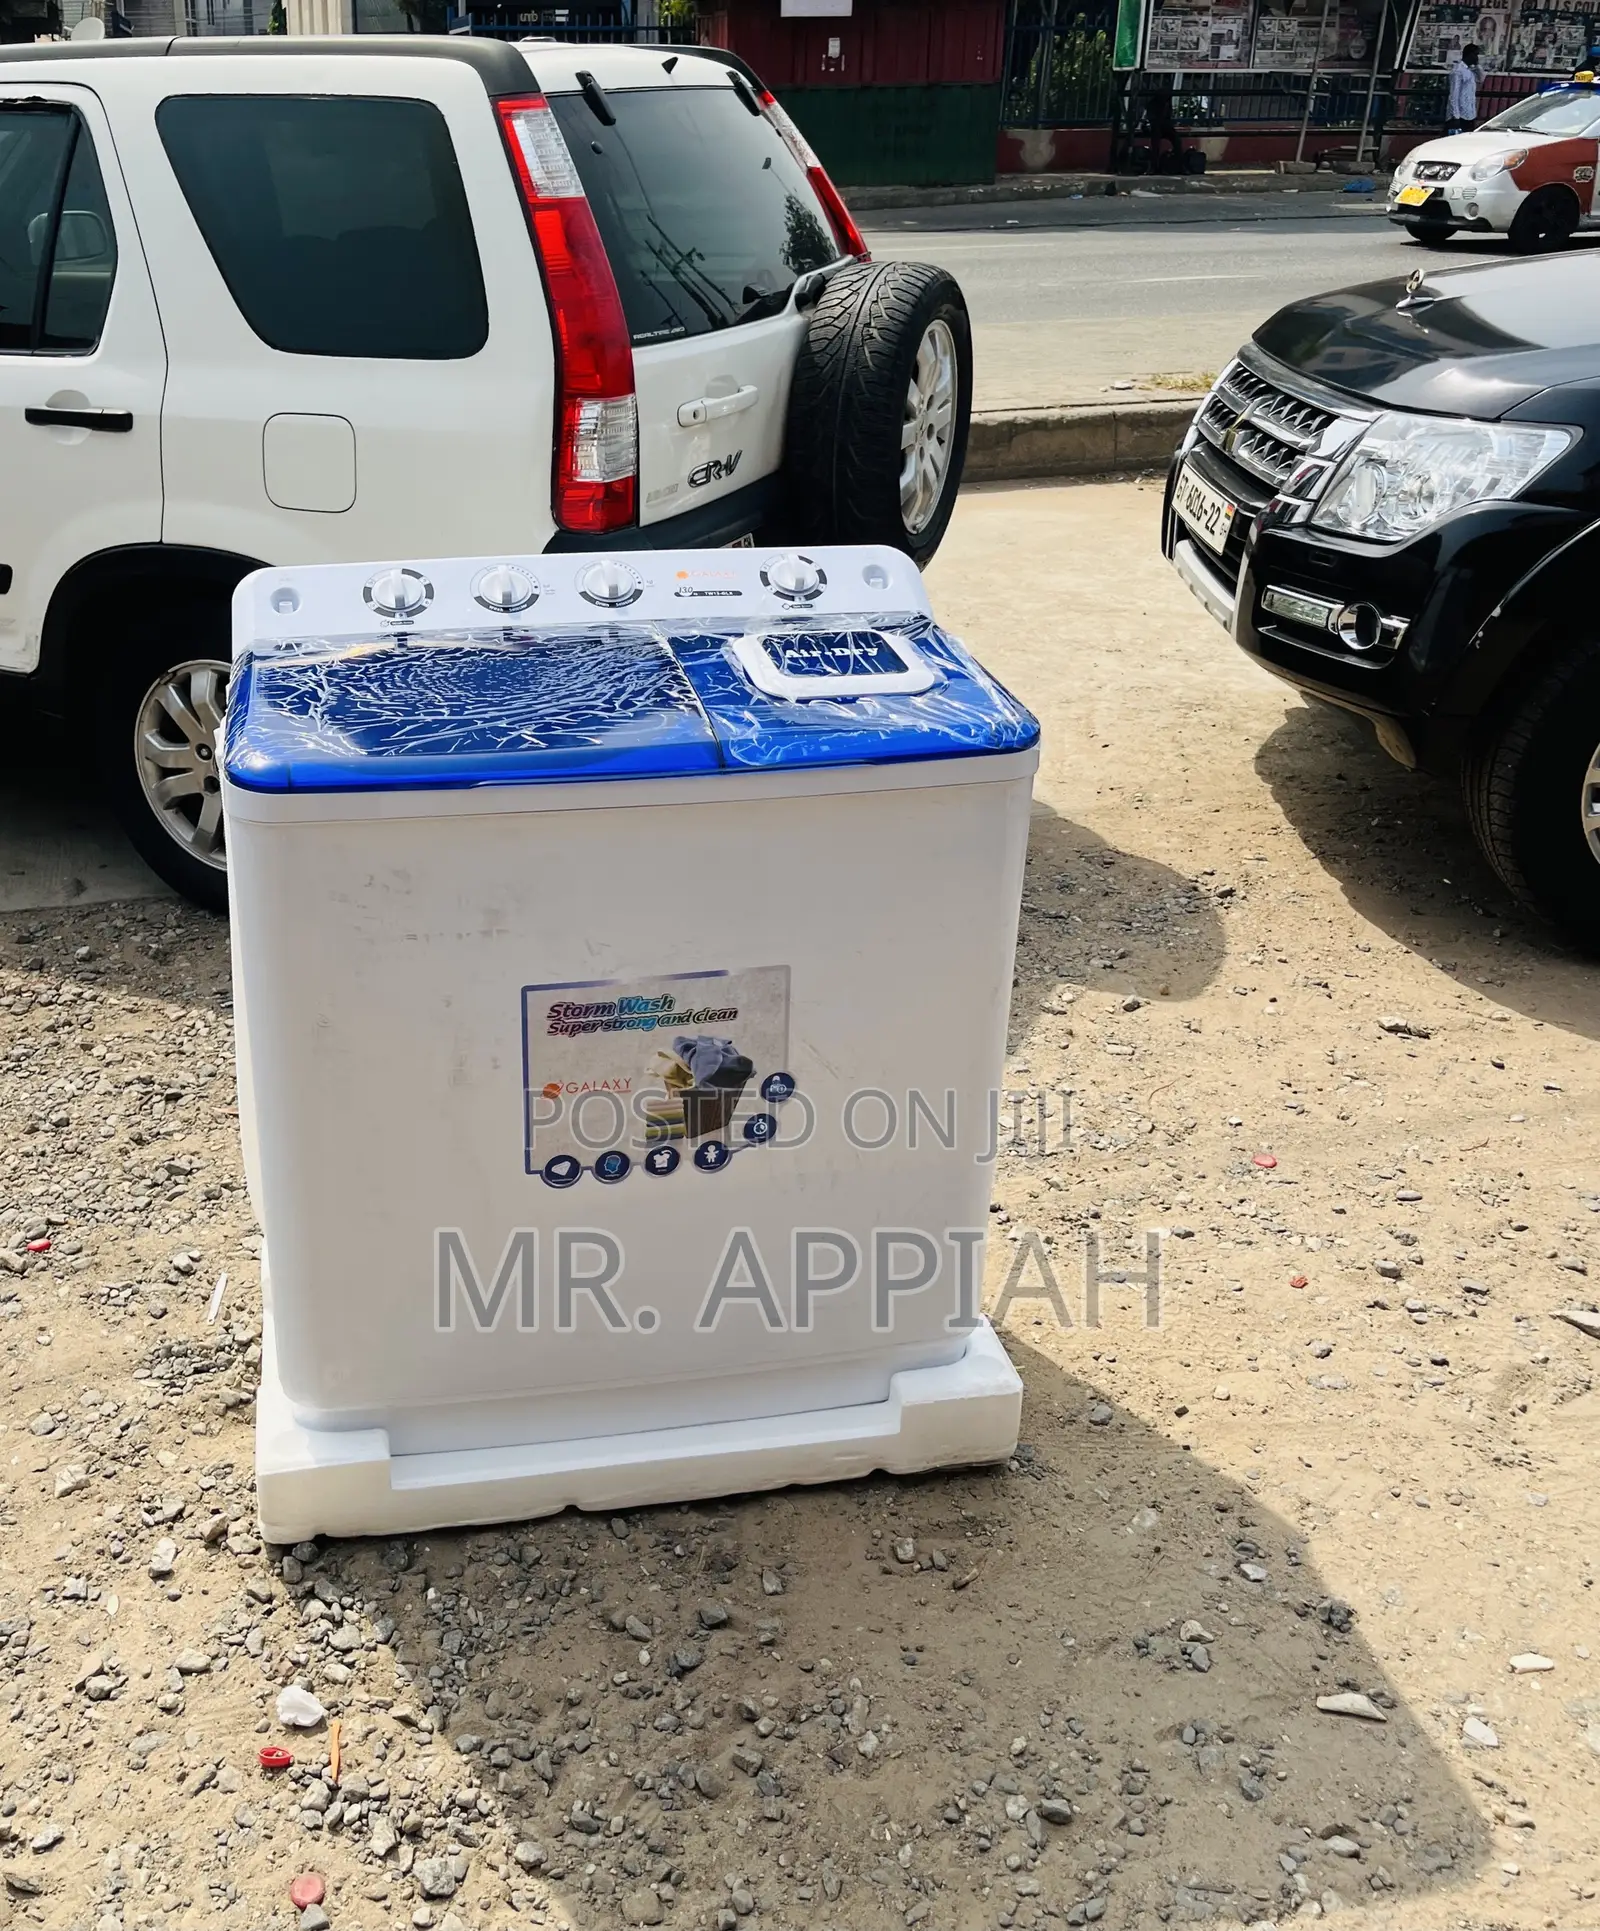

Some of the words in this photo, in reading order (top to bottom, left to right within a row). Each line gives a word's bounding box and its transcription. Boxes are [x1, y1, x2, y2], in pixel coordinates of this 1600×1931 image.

[547, 1001, 616, 1021] Storm
[617, 994, 676, 1016] Wash
[547, 1017, 602, 1038] Super
[565, 1077, 632, 1095] GALAXY
